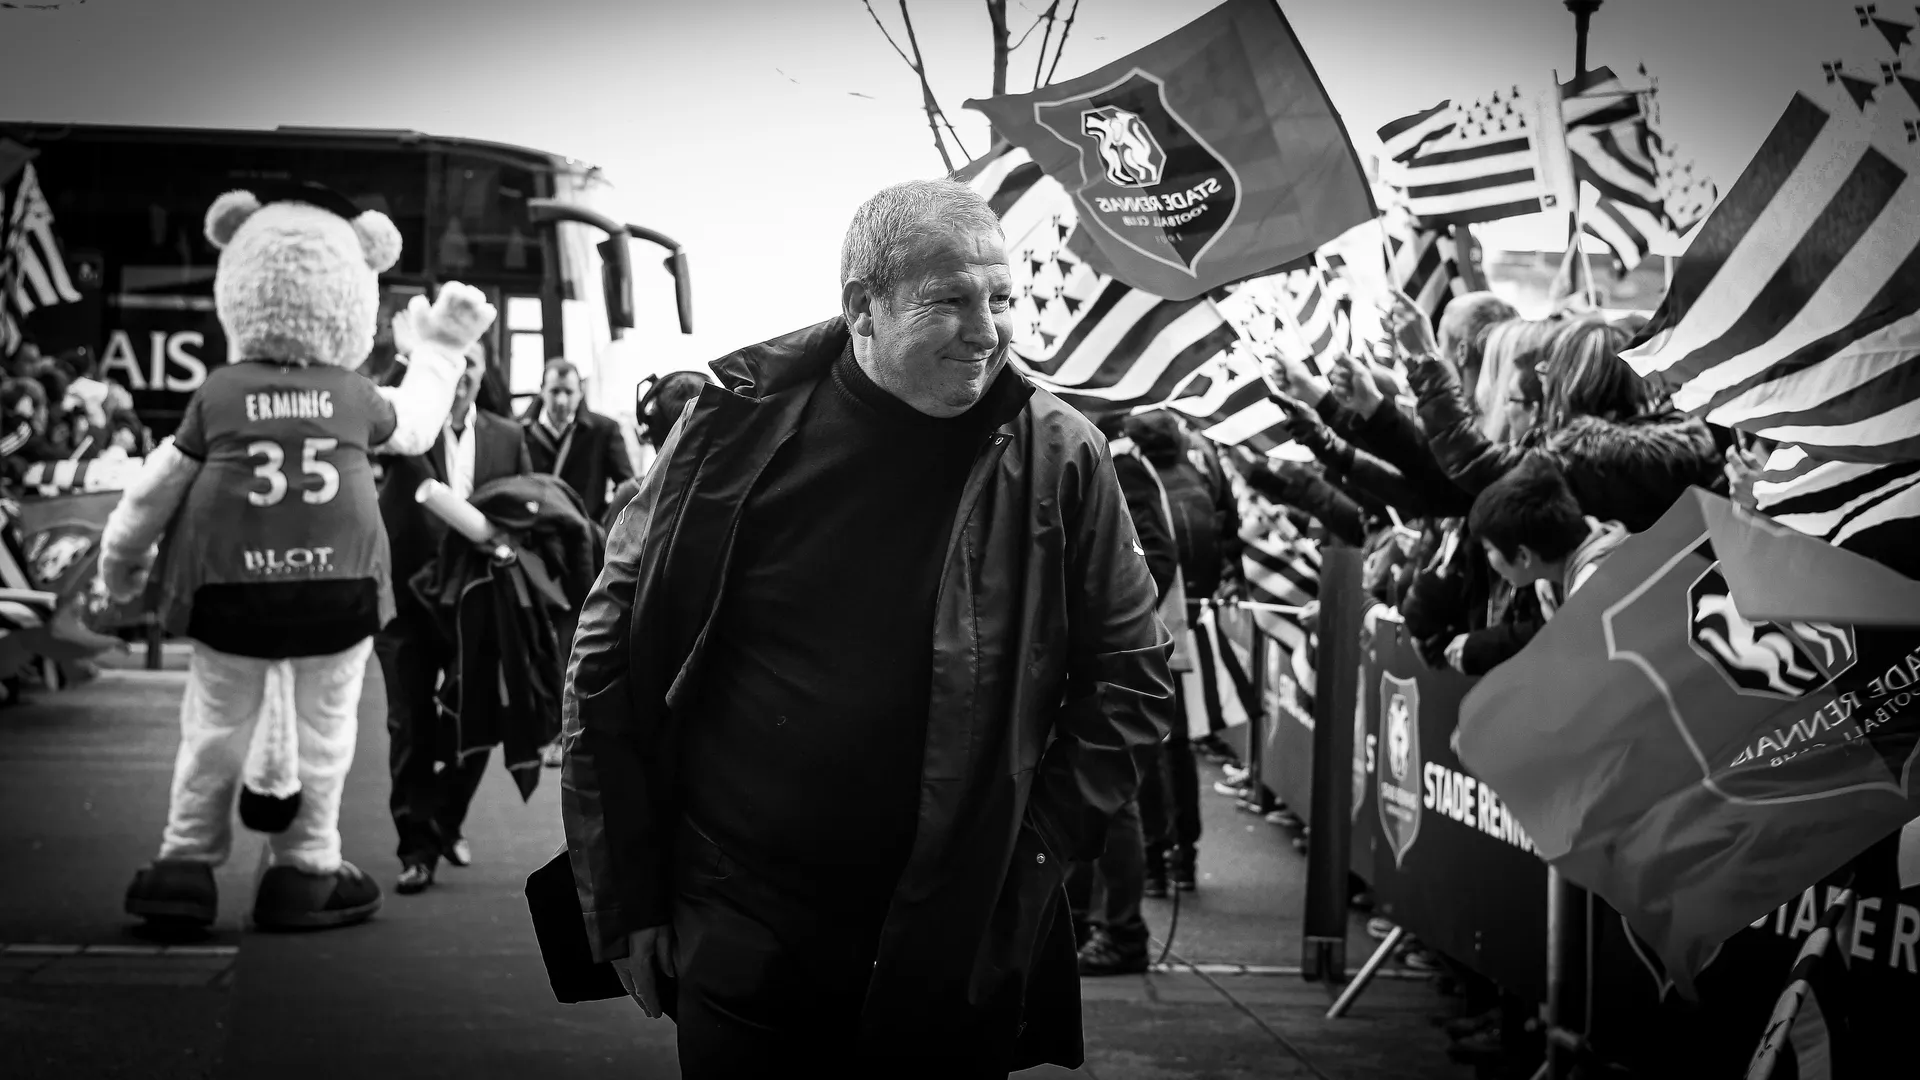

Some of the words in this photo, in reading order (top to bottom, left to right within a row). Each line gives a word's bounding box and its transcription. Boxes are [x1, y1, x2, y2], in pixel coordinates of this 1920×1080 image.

[101, 328, 208, 392] AIS
[244, 389, 335, 422] ERMINIG
[246, 437, 340, 507] 35
[243, 546, 335, 571] BLOT
[1423, 760, 1477, 828] STADE
[1478, 782, 1545, 857] RENN
